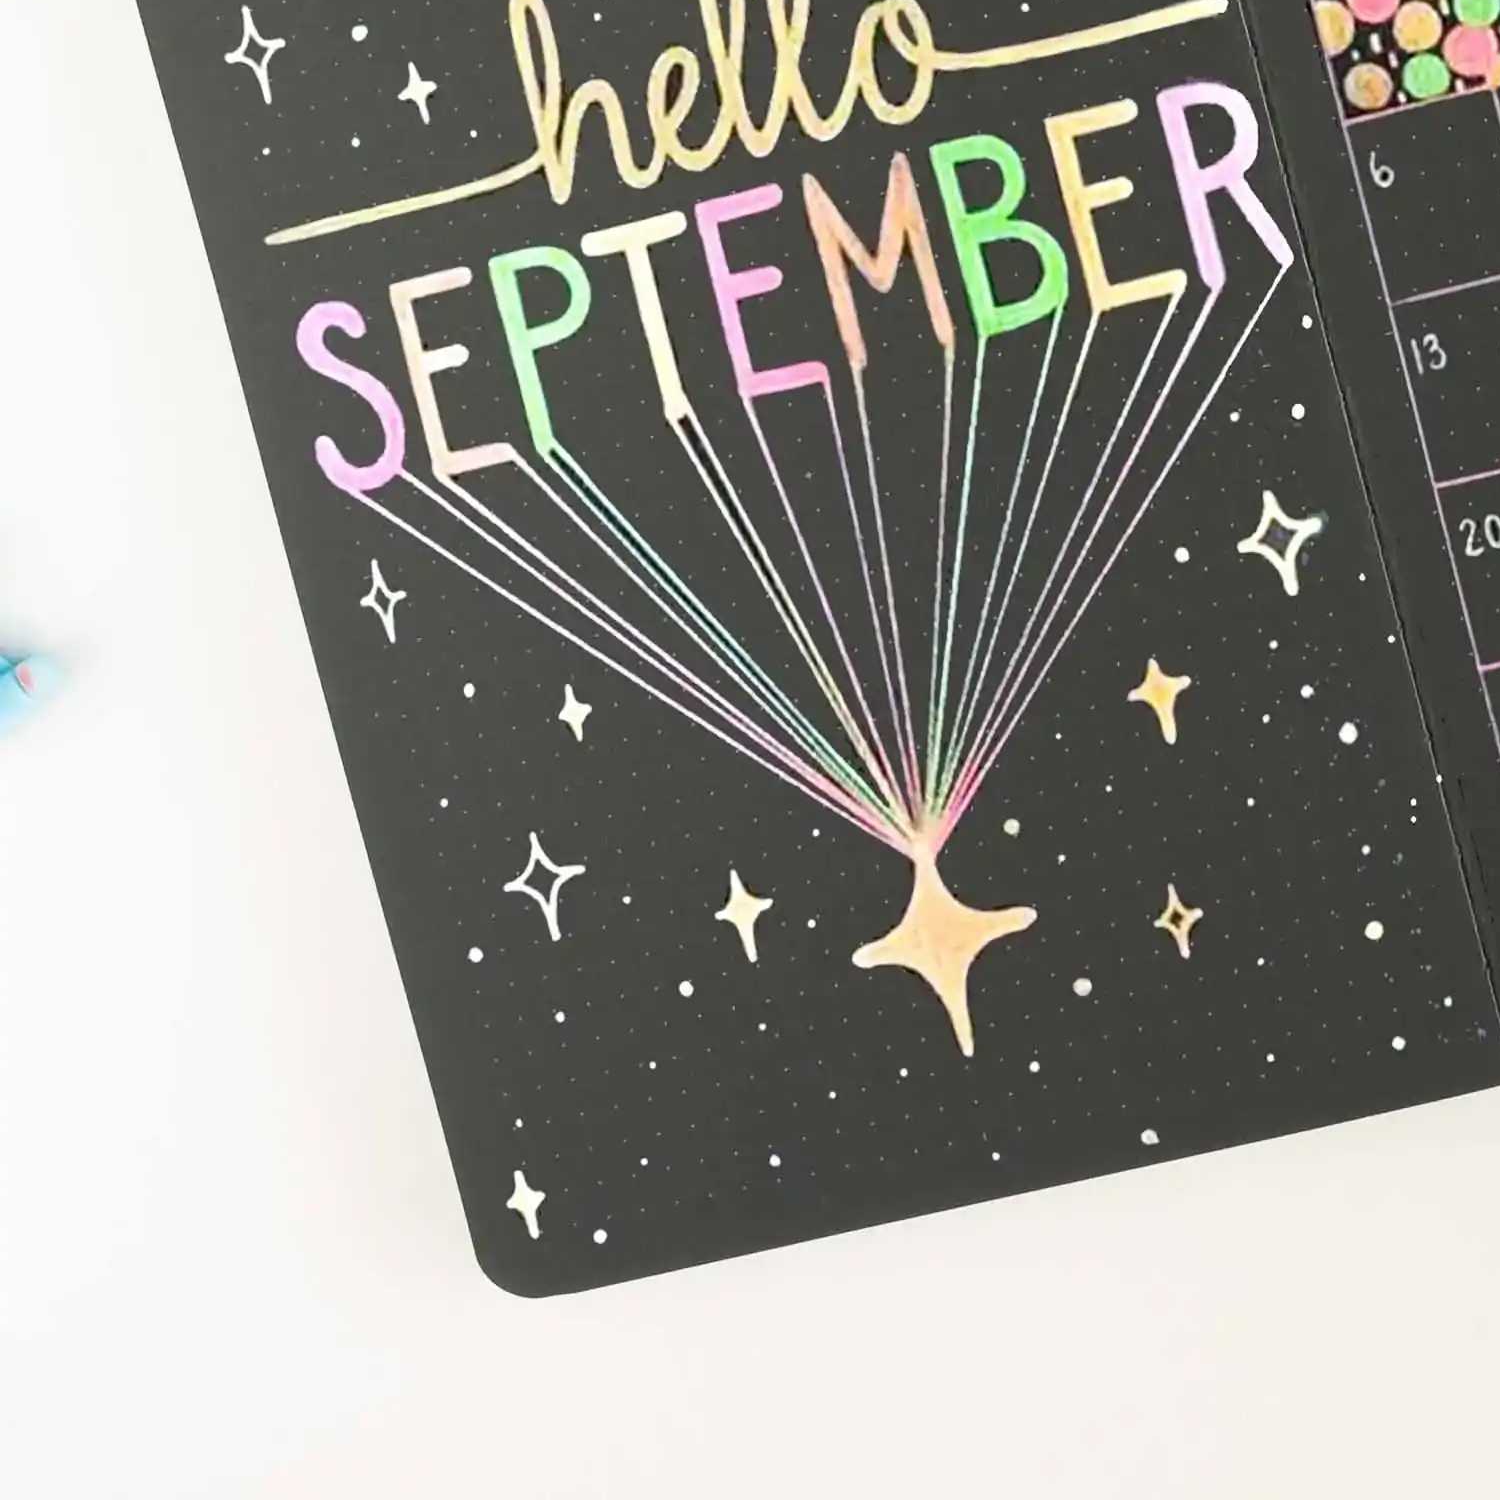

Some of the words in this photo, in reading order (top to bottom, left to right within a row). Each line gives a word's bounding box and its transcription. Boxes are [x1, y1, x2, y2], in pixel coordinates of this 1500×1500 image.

[1369, 151, 1395, 189] 6
[295, 81, 1295, 489] SEPTEMBER
[1410, 333, 1447, 375] 13
